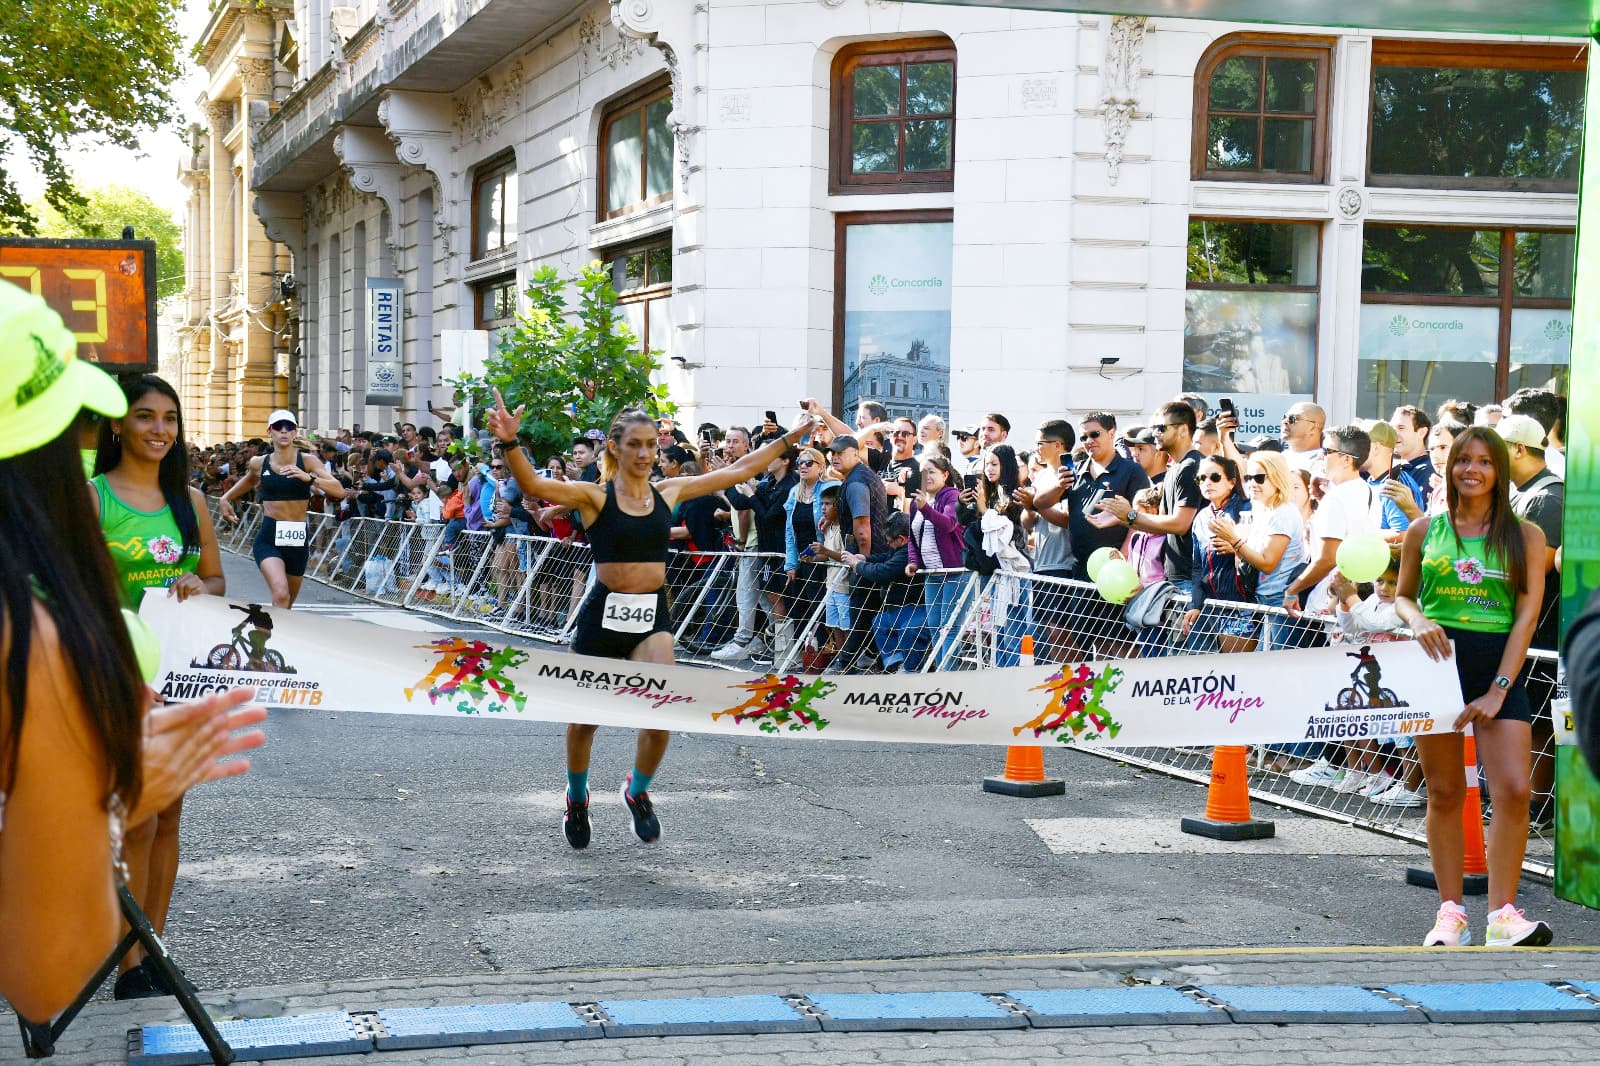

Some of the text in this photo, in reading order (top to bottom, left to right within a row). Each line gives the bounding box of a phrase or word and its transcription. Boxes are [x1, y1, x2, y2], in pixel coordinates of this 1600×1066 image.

[891, 277, 943, 288] Concordia
[378, 292, 392, 353] RENTAS
[1411, 319, 1464, 330] Concordia
[1244, 406, 1265, 418] tus
[1235, 421, 1281, 434] ciones
[277, 529, 306, 540] 1408
[128, 567, 183, 581] MARATÓN
[1466, 596, 1500, 611] Mujer
[606, 604, 654, 623] 1346
[164, 671, 320, 690] Asociación concordiense
[537, 664, 667, 691] MARATÓN
[1131, 669, 1236, 698] MARATÓN
[576, 681, 697, 709] DE LA Mujer
[843, 687, 963, 706] MARATÓN
[895, 706, 909, 714] LA
[912, 703, 990, 729] Mujer
[1163, 690, 1265, 724] DE LA Mujer
[1308, 710, 1430, 724] Asociación concordiense
